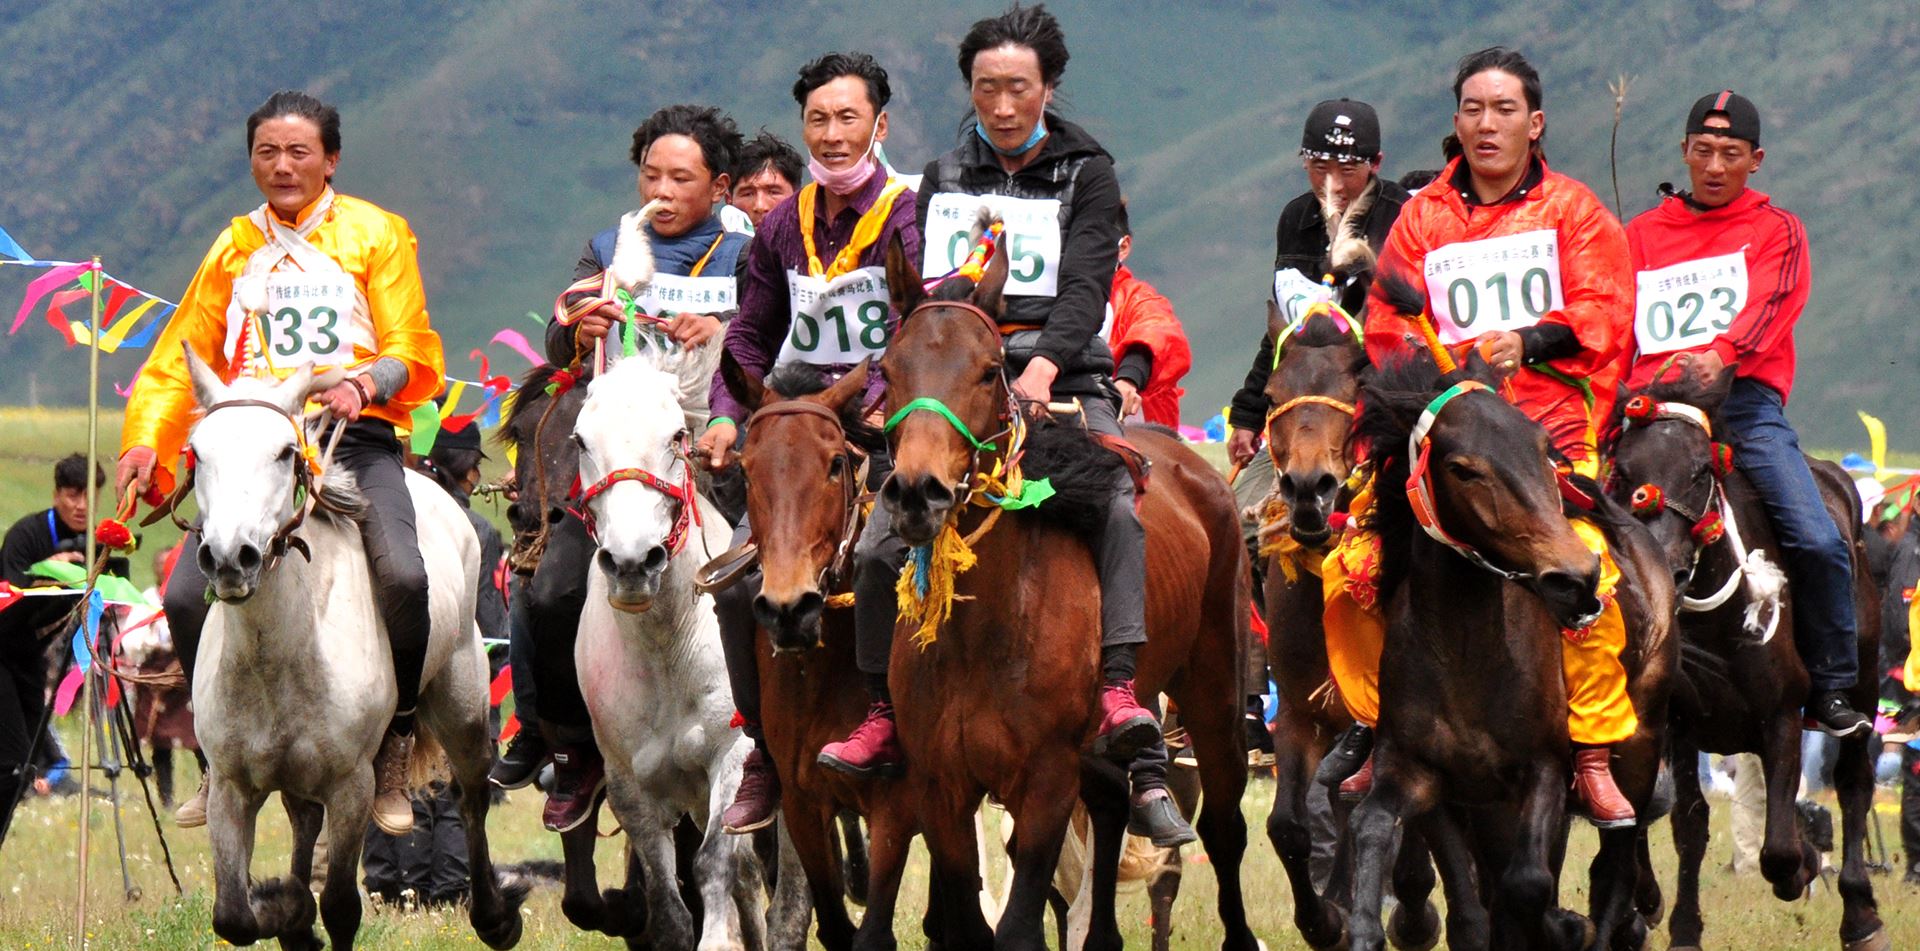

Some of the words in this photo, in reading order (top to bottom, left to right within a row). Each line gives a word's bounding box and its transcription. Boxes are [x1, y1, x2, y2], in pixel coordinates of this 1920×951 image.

[947, 230, 1045, 283] 05
[1447, 267, 1553, 329] 010
[1646, 287, 1738, 342] 023
[791, 300, 890, 352] 018
